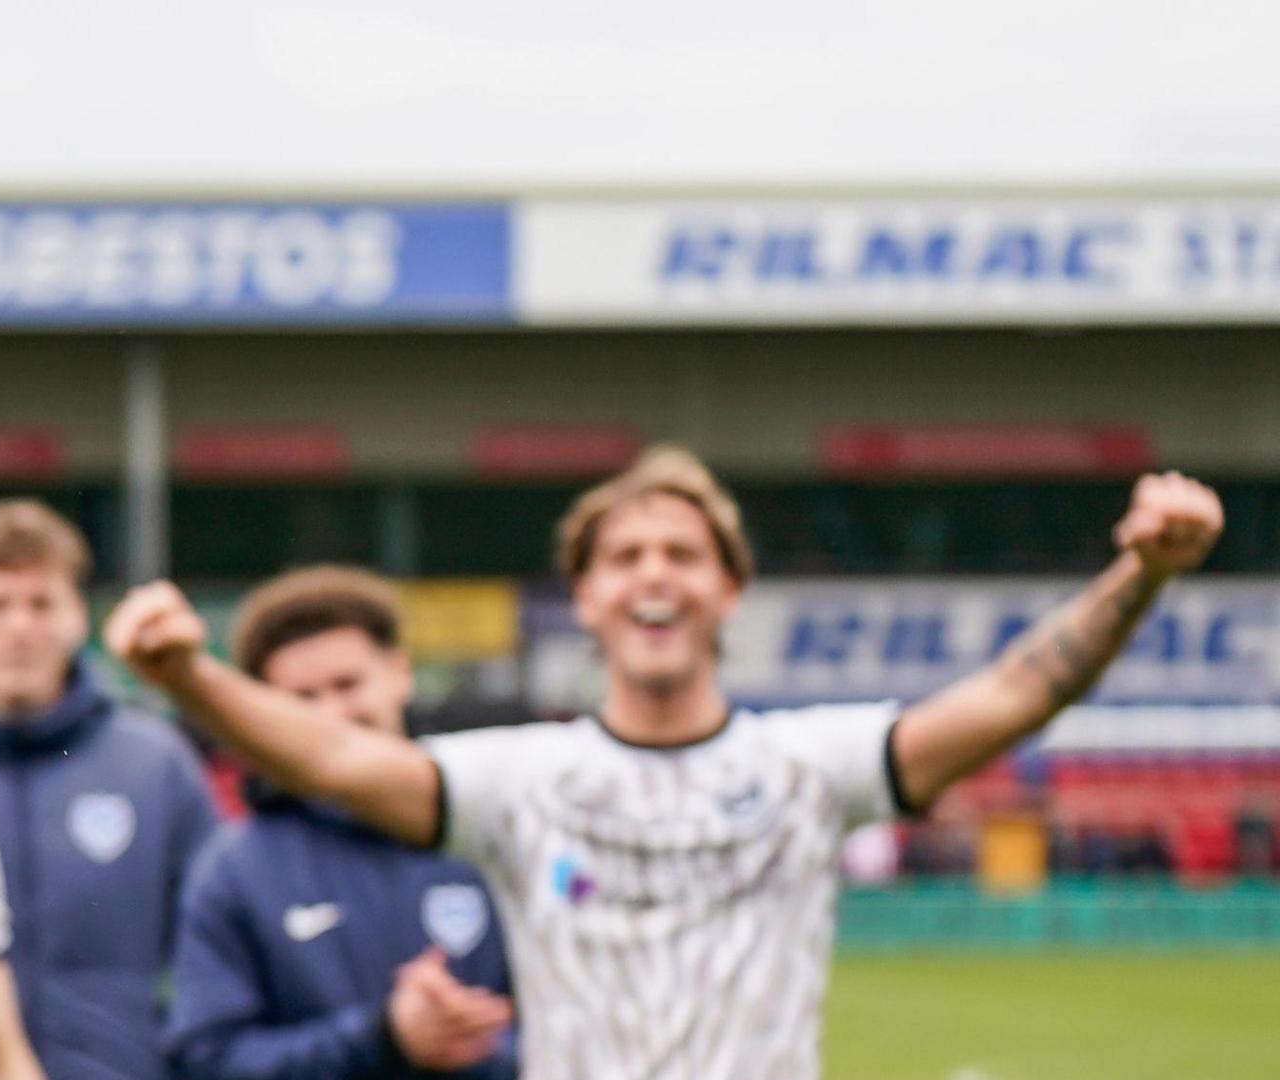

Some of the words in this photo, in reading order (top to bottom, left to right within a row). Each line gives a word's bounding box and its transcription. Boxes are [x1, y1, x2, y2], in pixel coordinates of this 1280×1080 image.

[662, 224, 1132, 285] RILMAC
[1178, 222, 1280, 284] ST
[783, 609, 1280, 666] RILAC
